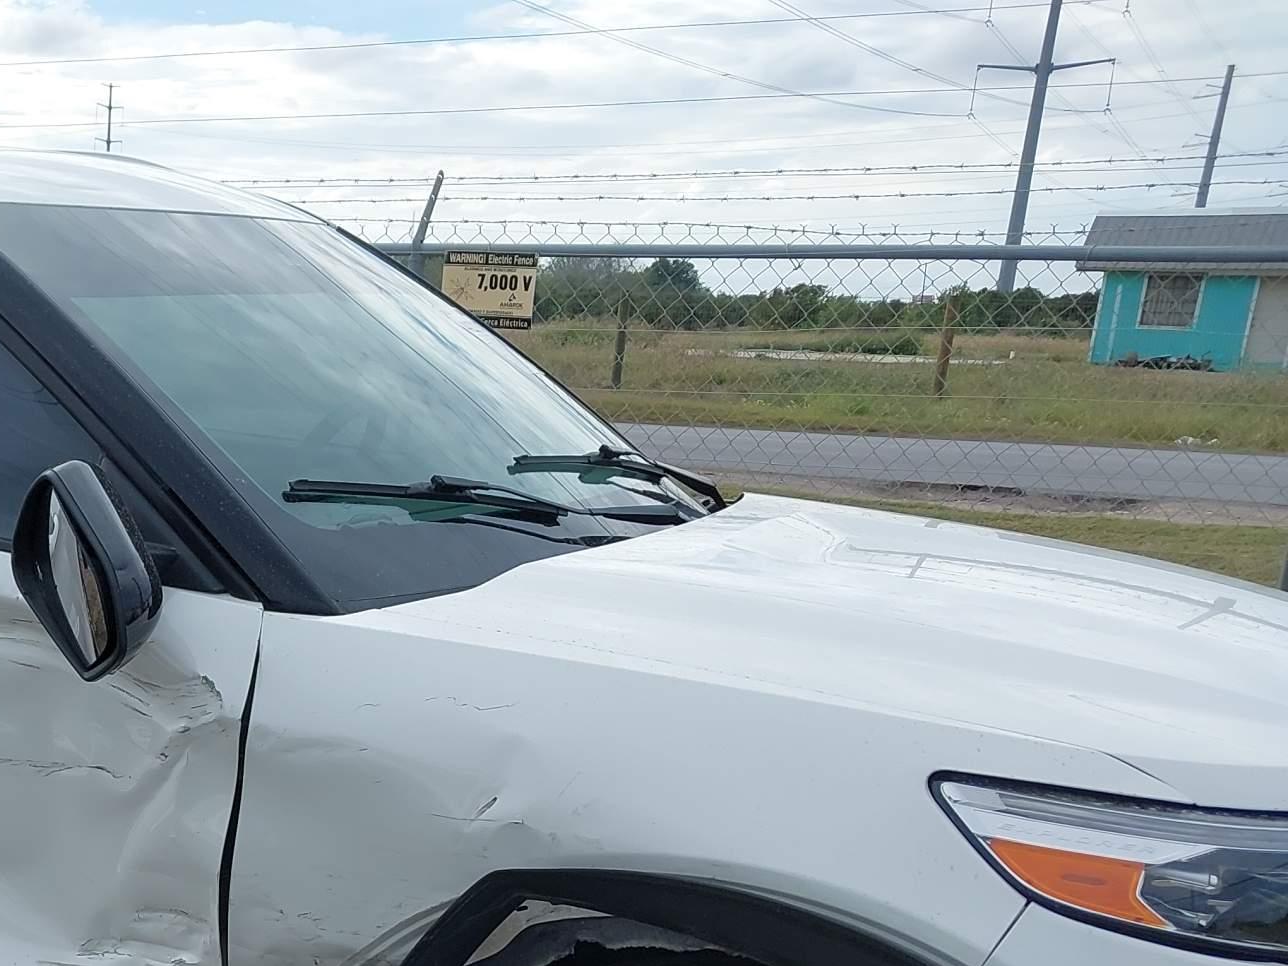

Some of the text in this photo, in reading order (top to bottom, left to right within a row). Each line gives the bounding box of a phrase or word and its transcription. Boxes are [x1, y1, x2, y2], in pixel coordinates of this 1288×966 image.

[449, 252, 534, 266] WARNING! Electric Fence
[477, 273, 533, 292] 7,000 V
[499, 318, 528, 328] Eléctrica
